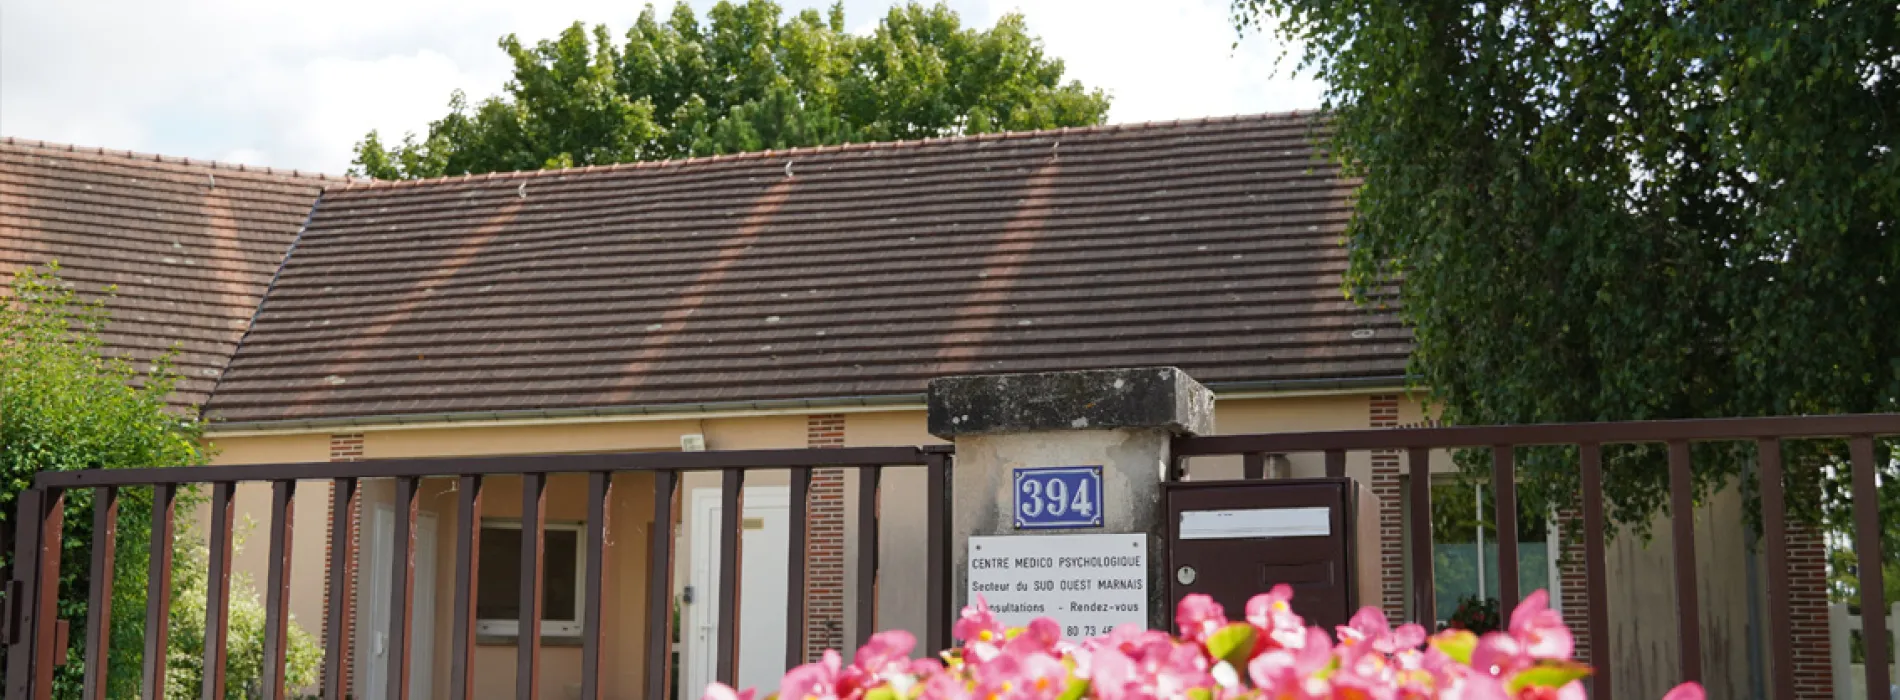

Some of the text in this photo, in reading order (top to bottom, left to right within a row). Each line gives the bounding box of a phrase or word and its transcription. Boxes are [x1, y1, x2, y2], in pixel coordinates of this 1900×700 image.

[1021, 477, 1093, 518] 394
[972, 555, 1141, 569] CENTRE MEDICO PSYCHOLOGIQUE
[972, 579, 1143, 592] Secteur du SUD OUEST MARNAIS
[977, 602, 1045, 613] nsultations
[1070, 601, 1139, 612] Rendez-vous
[1066, 625, 1079, 637] 80
[1085, 625, 1096, 637] 73
